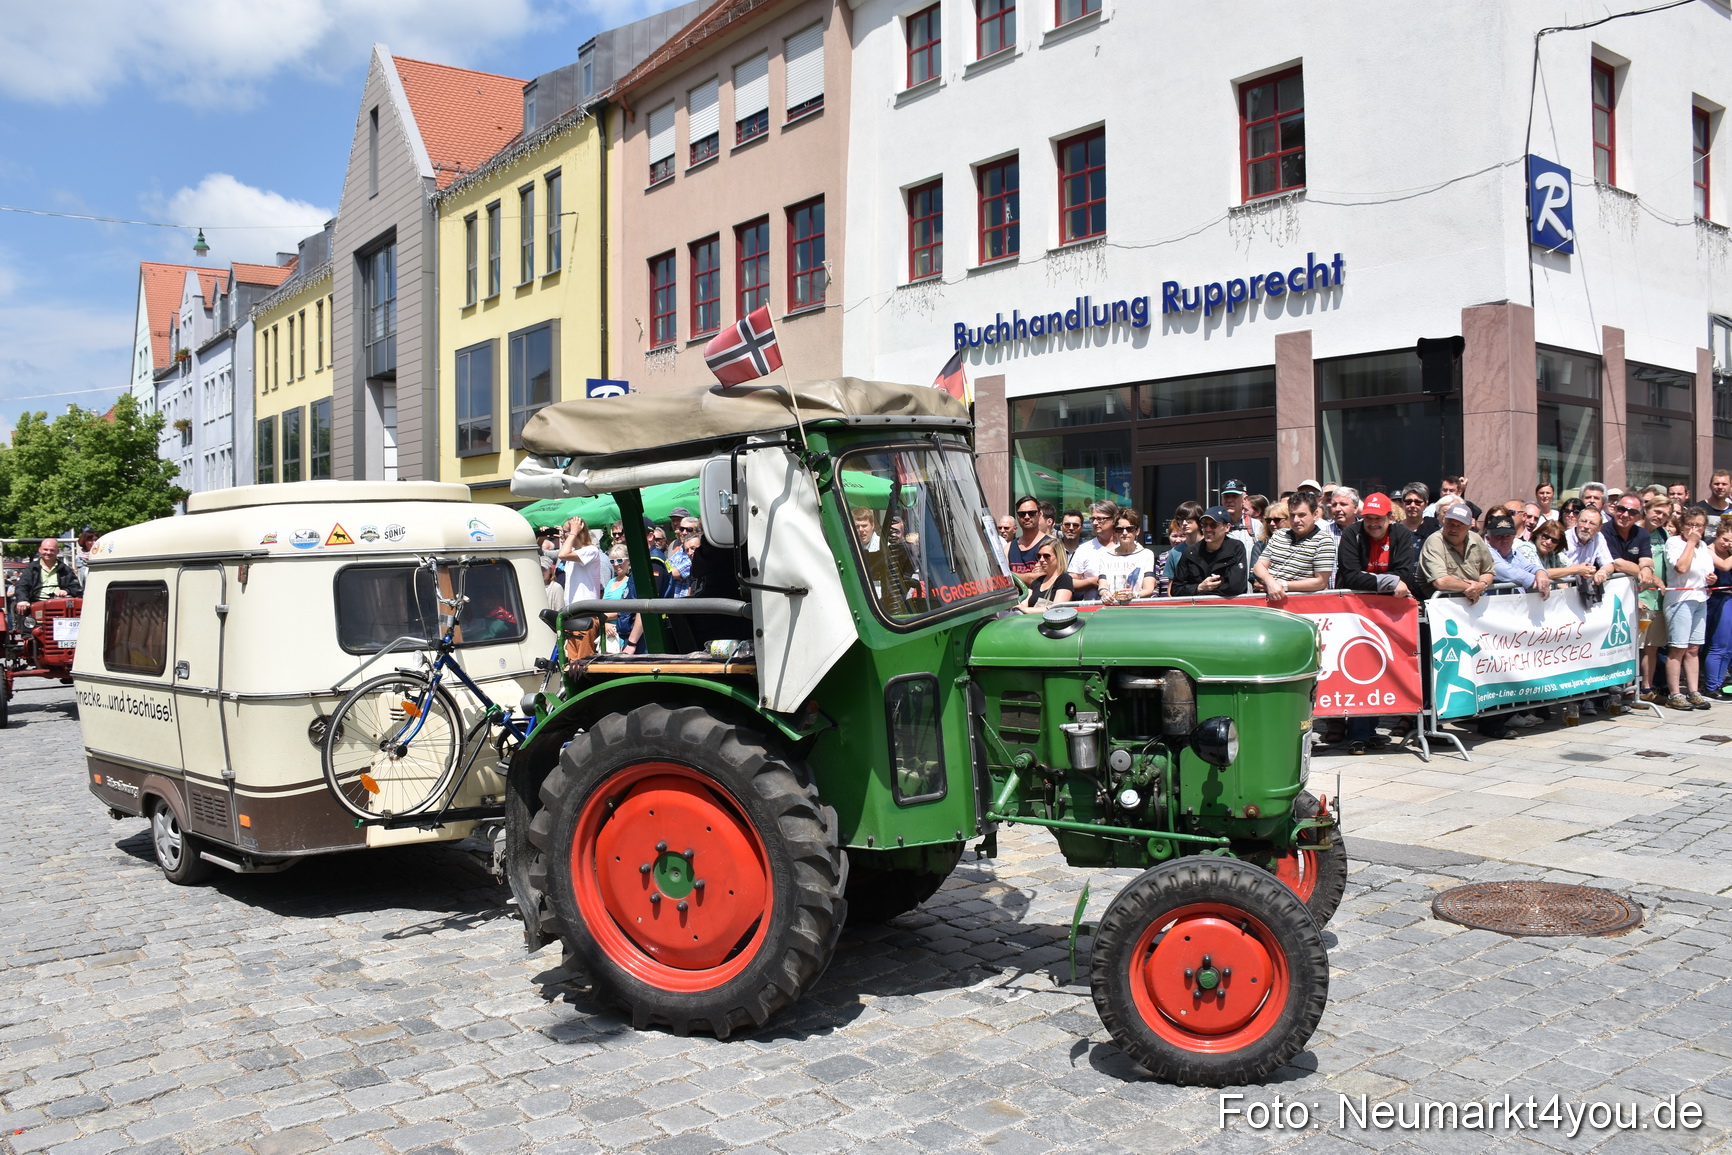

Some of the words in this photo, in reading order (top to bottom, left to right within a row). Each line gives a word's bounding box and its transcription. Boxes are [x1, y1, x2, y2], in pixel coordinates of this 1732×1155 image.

[954, 296, 1151, 350] Buchhandlung
[1162, 252, 1346, 317] Rupprecht
[385, 527, 405, 540] SONIC
[1533, 642, 1593, 668] BESSER.
[126, 694, 173, 723] tschüss!
[1313, 689, 1396, 708] etz.de
